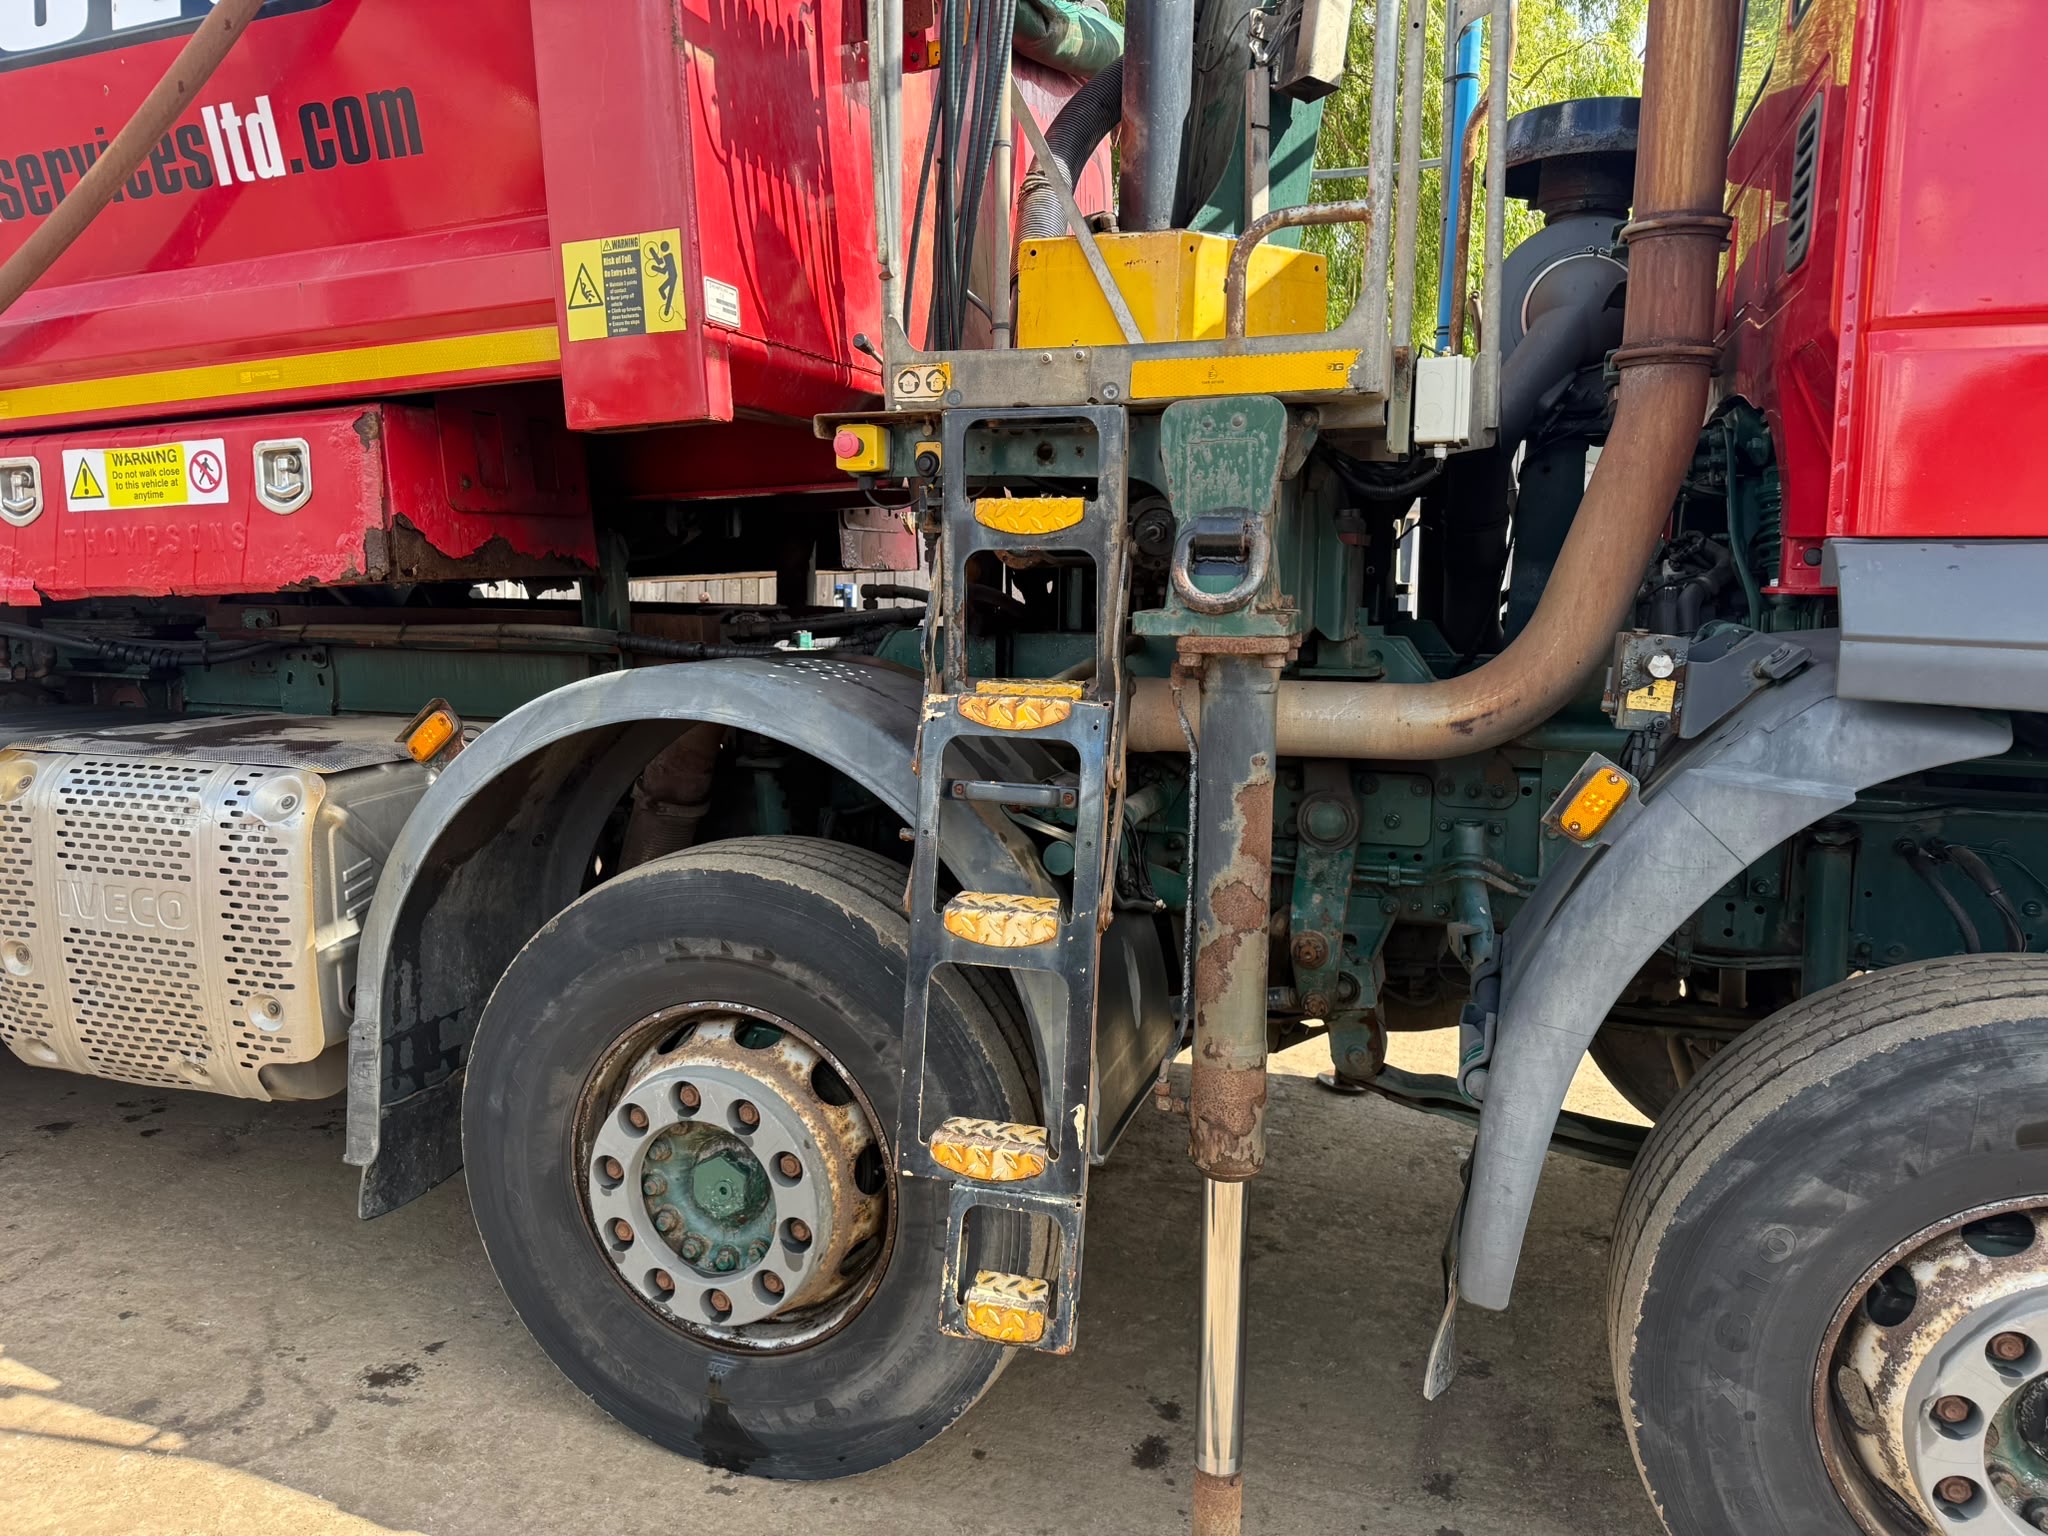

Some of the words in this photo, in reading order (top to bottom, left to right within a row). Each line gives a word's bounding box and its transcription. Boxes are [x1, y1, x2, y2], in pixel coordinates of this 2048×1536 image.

[612, 237, 638, 249] WARNING
[610, 269, 623, 277] Entry
[112, 449, 177, 466] WARNING
[112, 471, 124, 480] Do
[125, 469, 138, 479] not
[139, 468, 157, 477] walk
[159, 466, 180, 476] close
[116, 482, 123, 490] to
[125, 480, 139, 489] this
[141, 478, 168, 488] vehicle
[170, 479, 178, 487] at
[134, 491, 164, 502] anytime
[64, 521, 249, 558] THOMPSONS
[56, 880, 190, 930] IVECO
